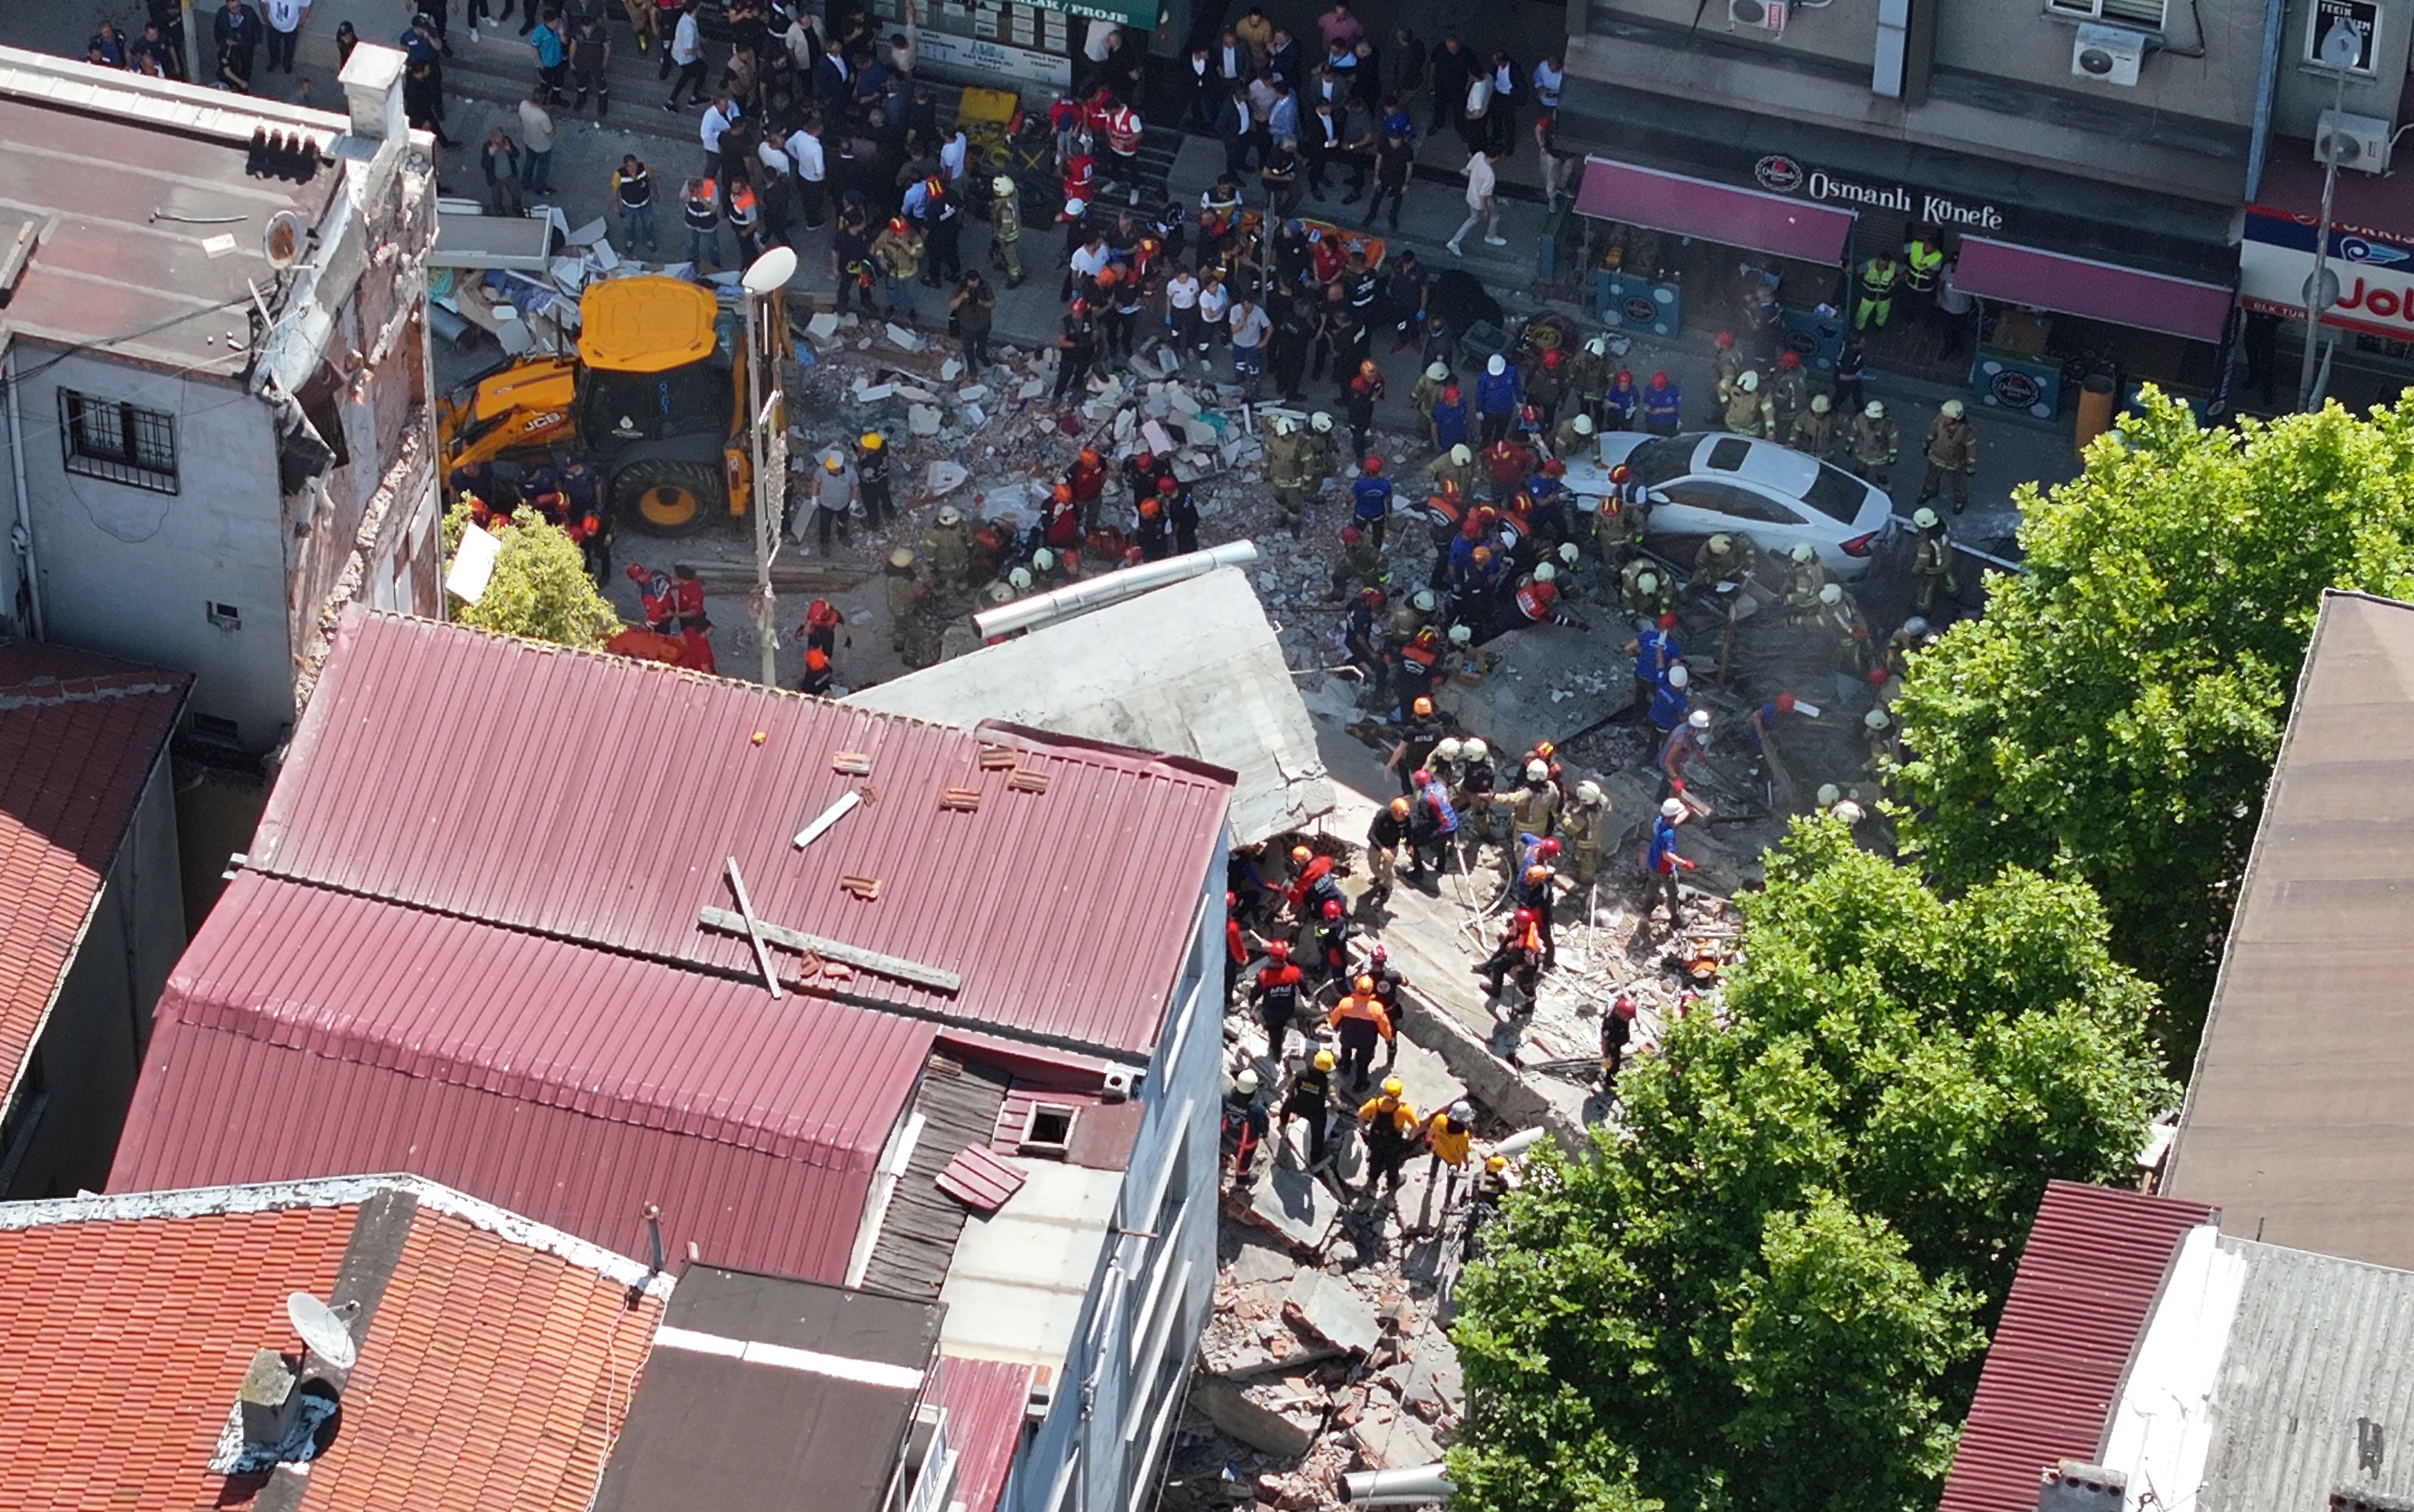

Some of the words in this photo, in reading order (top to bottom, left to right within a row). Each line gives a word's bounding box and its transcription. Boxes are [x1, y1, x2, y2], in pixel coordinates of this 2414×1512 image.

[1070, 6, 1129, 23] PROJE
[1809, 172, 1911, 212] Osmanlı
[1922, 195, 2003, 231] Künefe
[2281, 307, 2305, 319] TUR
[524, 413, 560, 431] JCB
